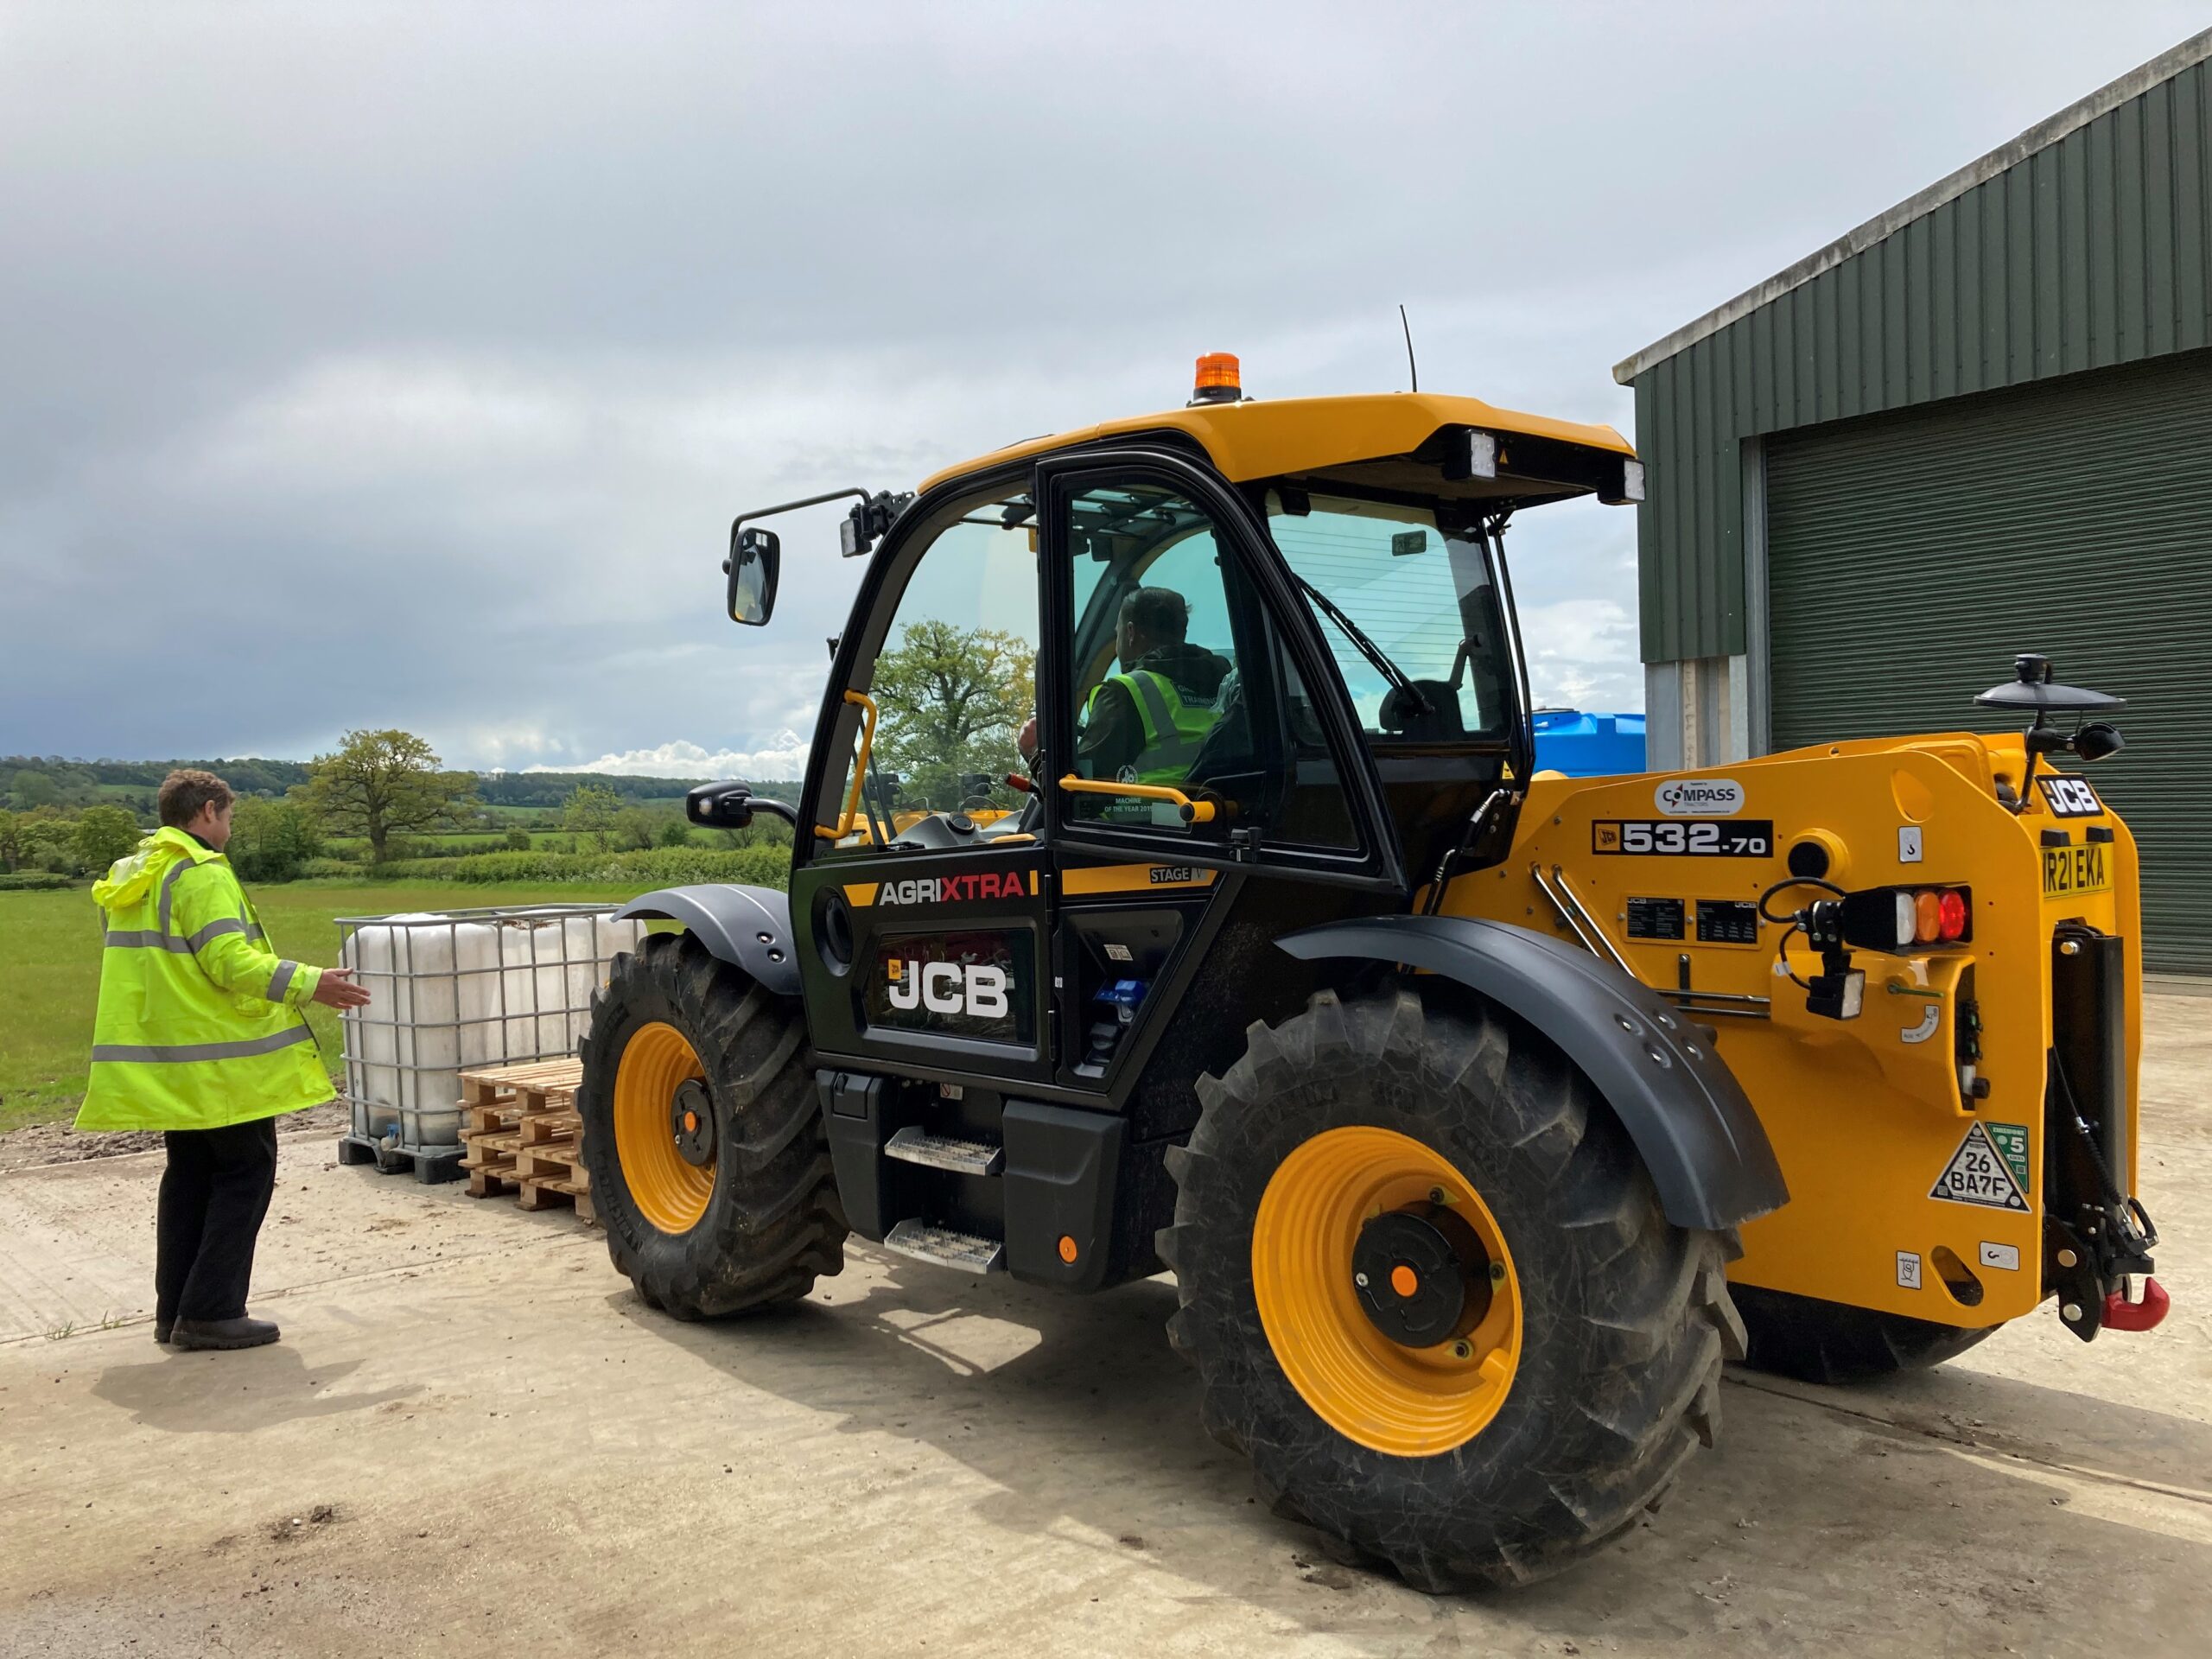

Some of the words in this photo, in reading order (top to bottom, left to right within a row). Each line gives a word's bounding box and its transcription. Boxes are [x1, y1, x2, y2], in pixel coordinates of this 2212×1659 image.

[1662, 788, 1735, 802] COMPASS
[2049, 779, 2101, 813] JCB
[1624, 823, 1766, 854] 532-70
[1151, 868, 1190, 881] STAGE
[2076, 848, 2106, 888] EKA
[879, 872, 1024, 906] AGRIXTRA
[889, 960, 1008, 1018] JCB
[2011, 1136, 2024, 1154] 5
[1966, 1152, 1991, 1173] 26
[1951, 1172, 2006, 1197] BA7F
